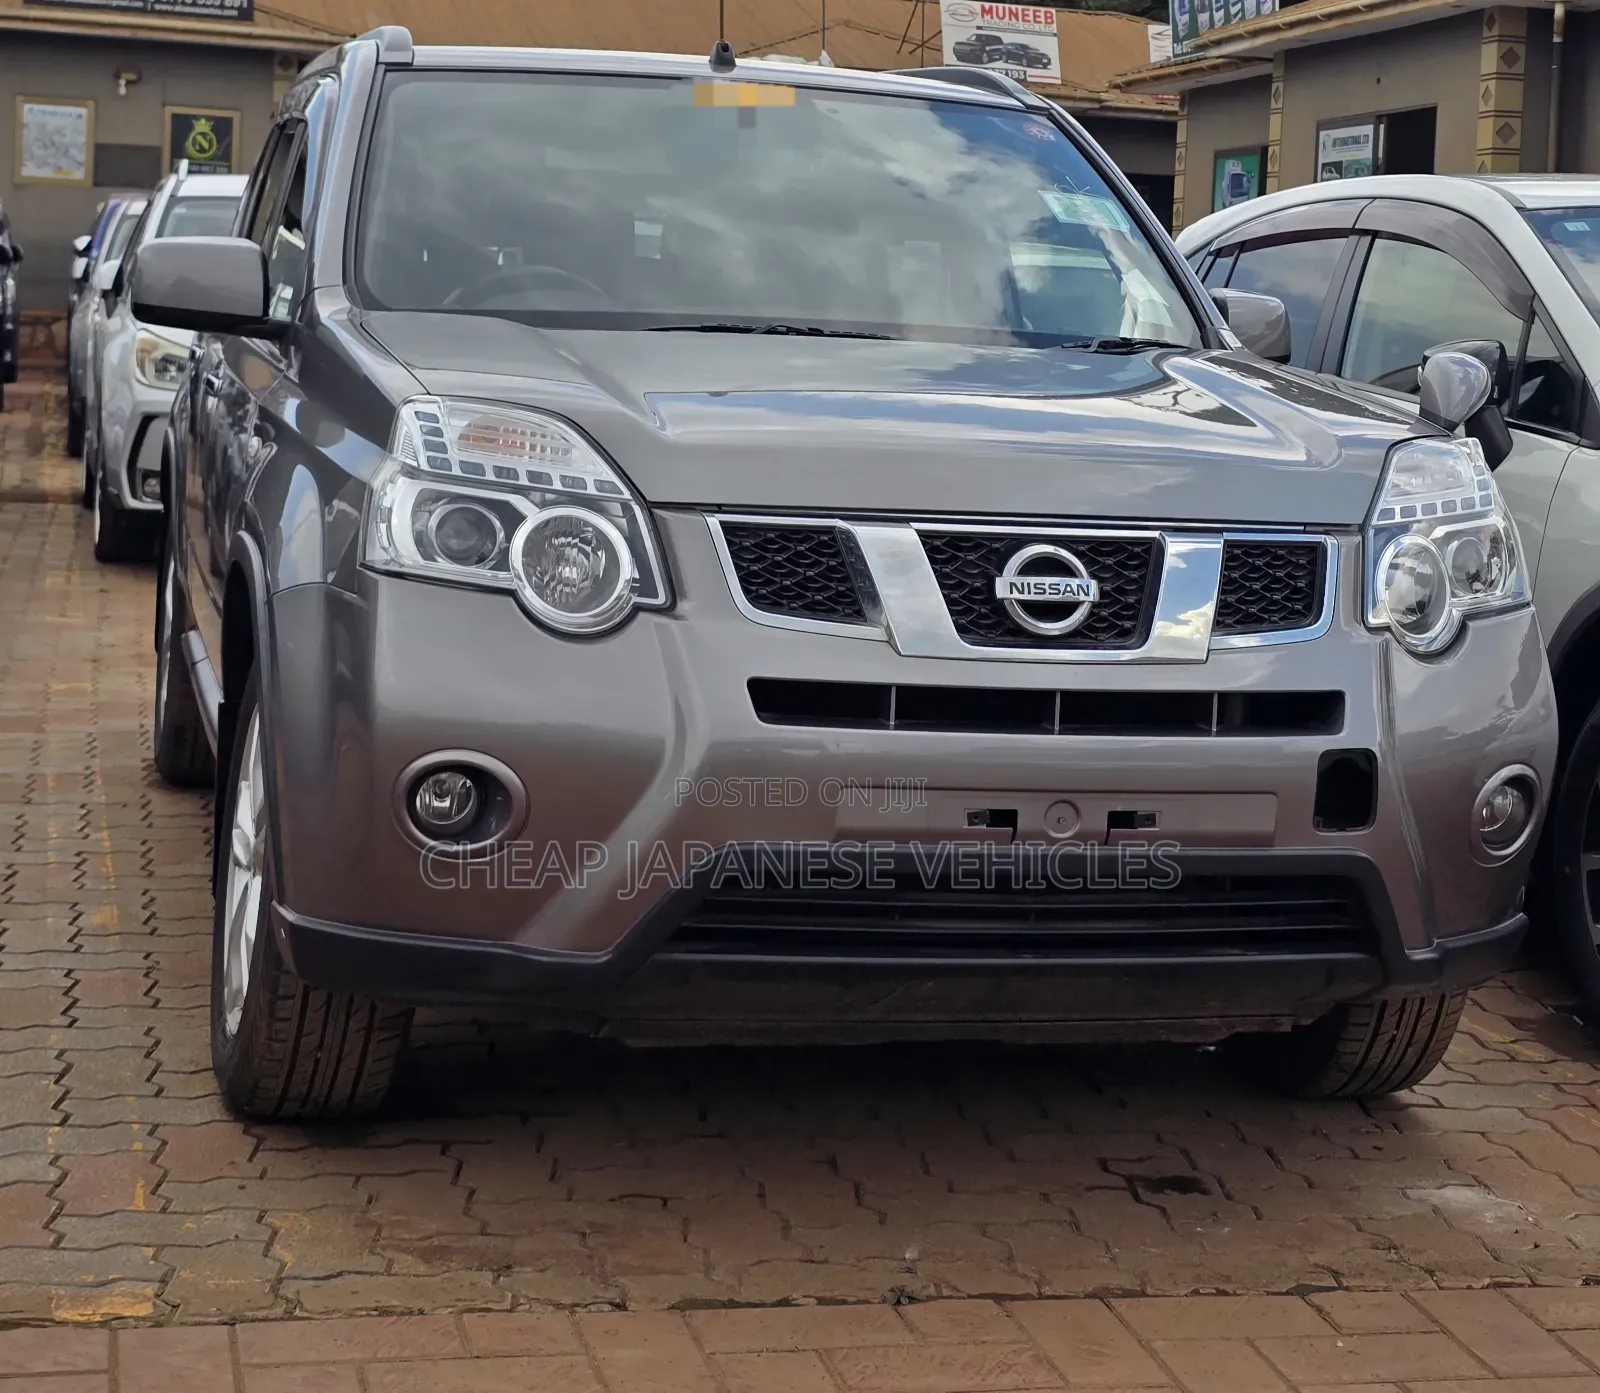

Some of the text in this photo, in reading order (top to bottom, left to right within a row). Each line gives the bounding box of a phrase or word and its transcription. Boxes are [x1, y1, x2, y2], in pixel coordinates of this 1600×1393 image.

[980, 4, 1054, 25] MUNEEB
[982, 19, 1020, 29] TRADING
[1009, 581, 1090, 597] NISSAN
